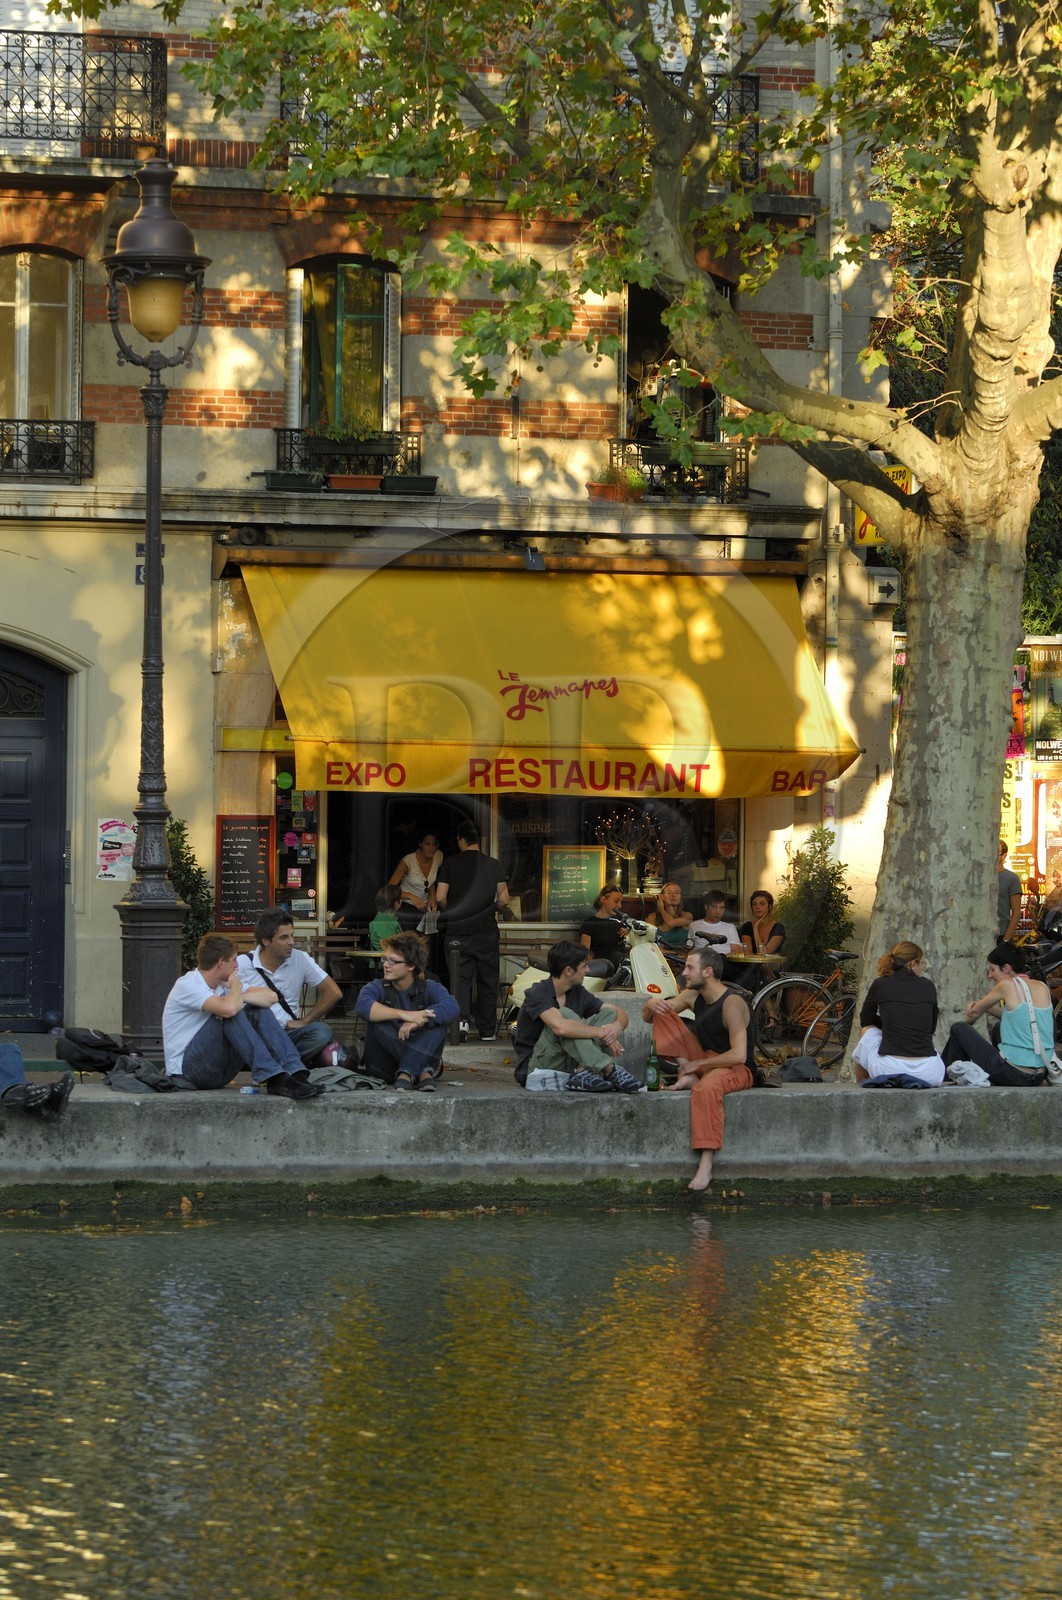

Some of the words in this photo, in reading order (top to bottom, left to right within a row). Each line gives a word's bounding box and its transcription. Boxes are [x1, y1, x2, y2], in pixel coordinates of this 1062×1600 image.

[497, 669, 520, 681] LE
[499, 677, 619, 721] Jemmapes
[326, 761, 406, 787] EXPO
[469, 758, 710, 793] RESTAURANT
[771, 769, 828, 792] BAR
[511, 823, 551, 833] CUISINE
